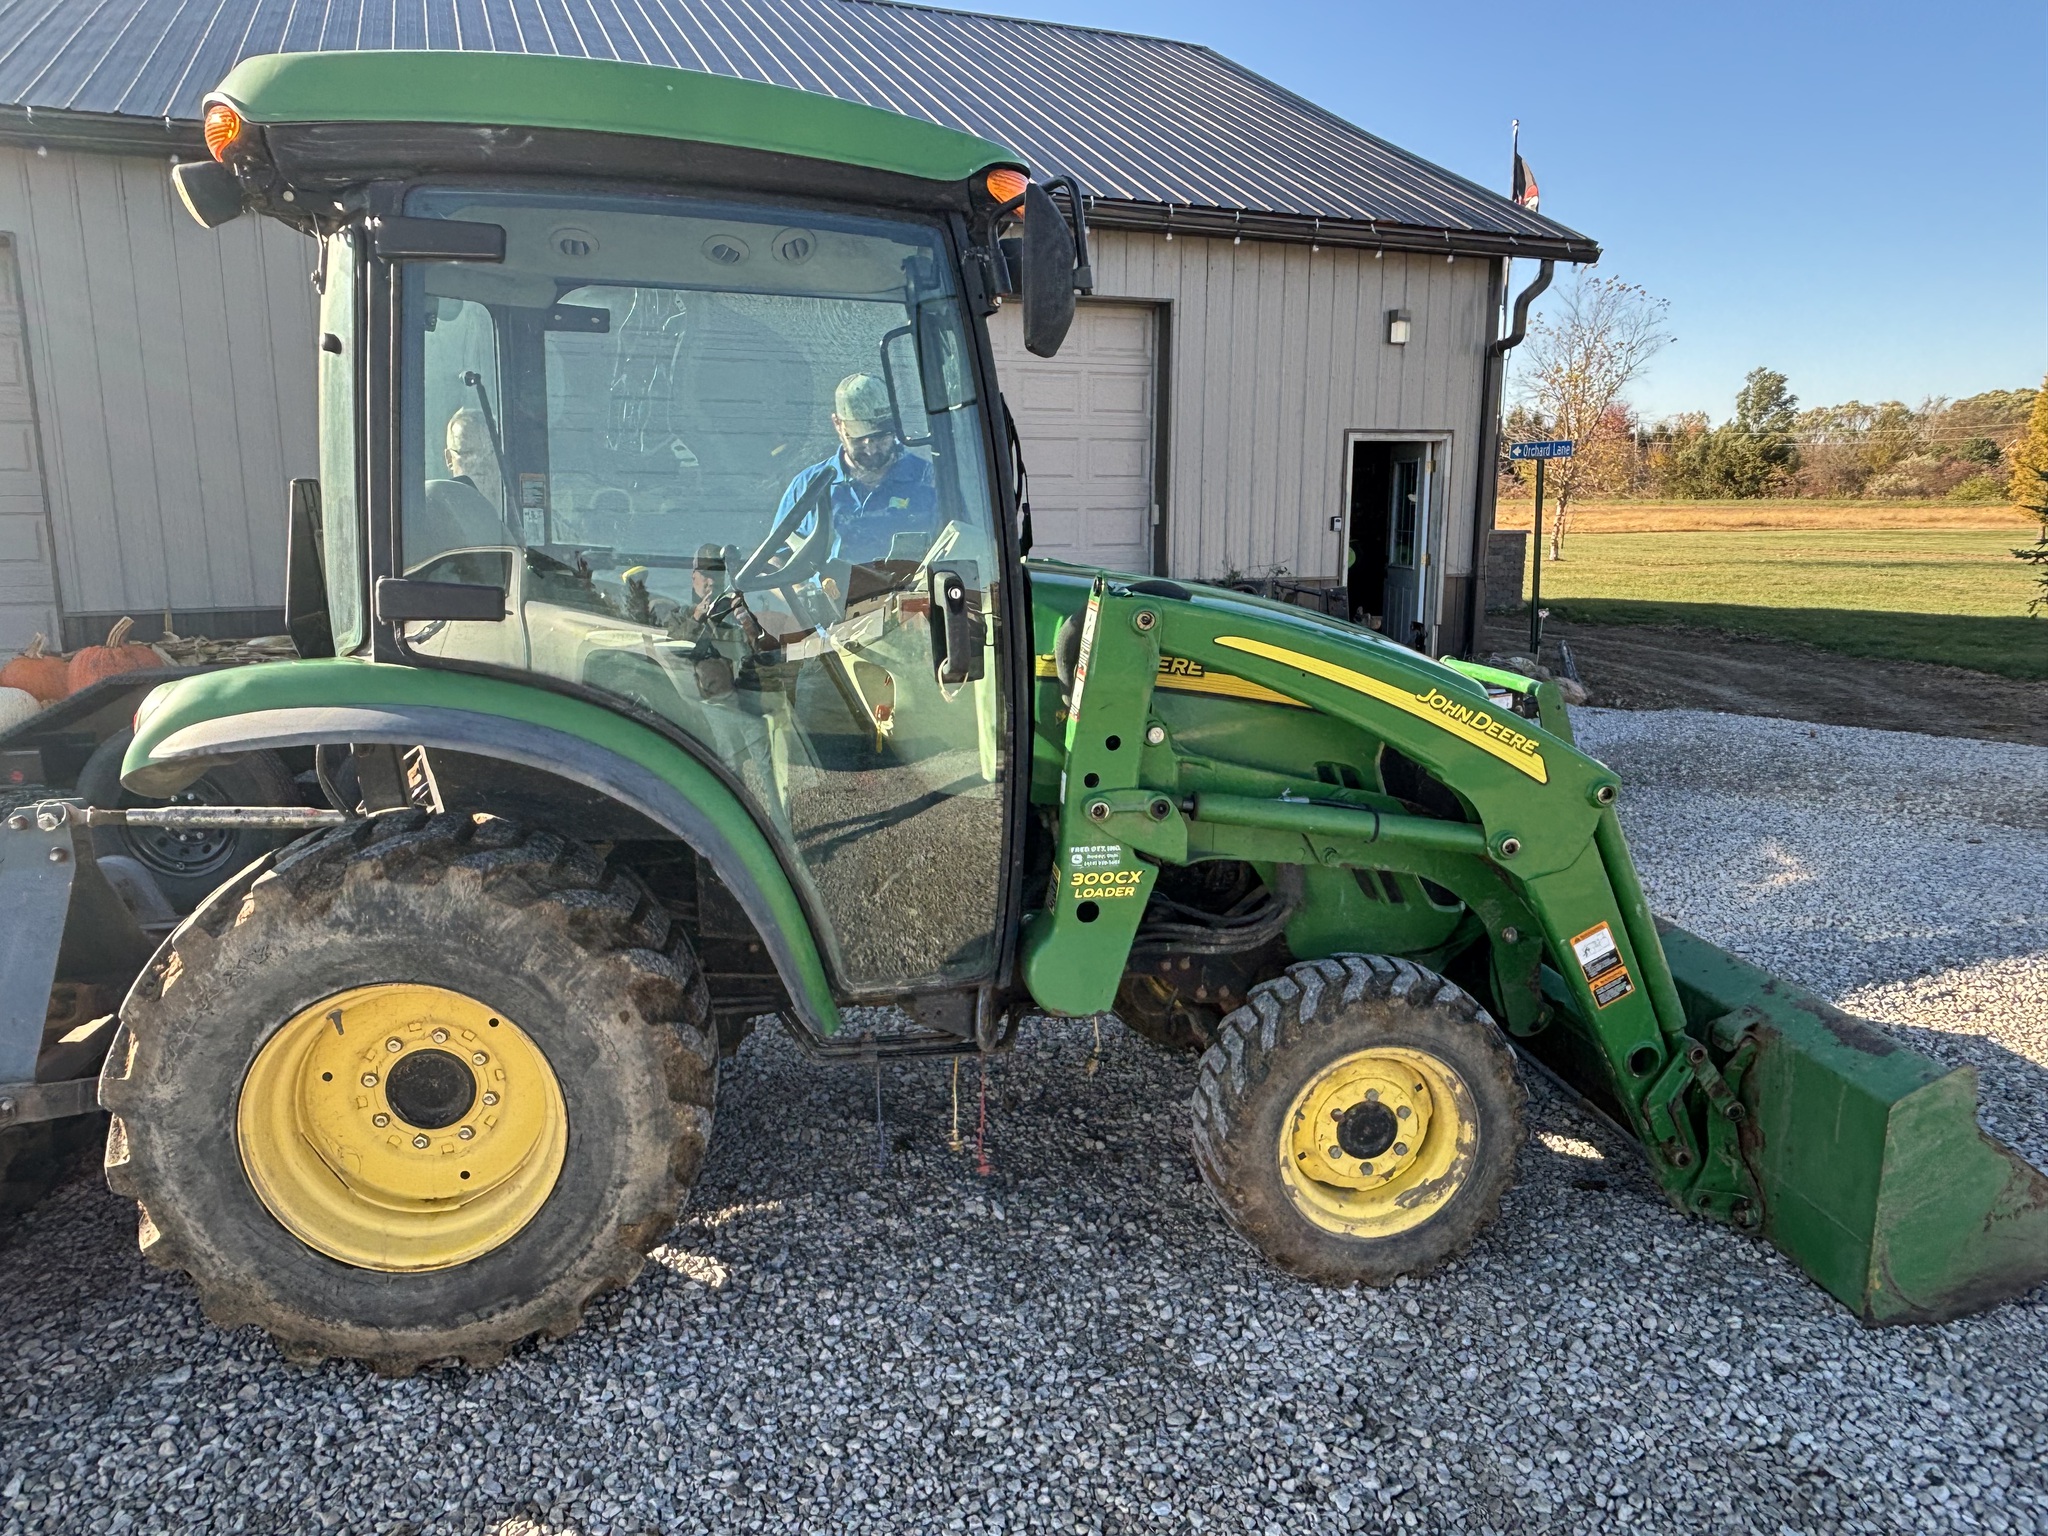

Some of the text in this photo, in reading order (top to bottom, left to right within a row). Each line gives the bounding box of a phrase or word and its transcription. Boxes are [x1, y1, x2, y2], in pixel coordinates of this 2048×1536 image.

[1523, 442, 1570, 457] Orchard Lane
[1158, 656, 1203, 676] ERE
[1070, 870, 1143, 886] 300CX
[1074, 886, 1135, 898] LOADER
